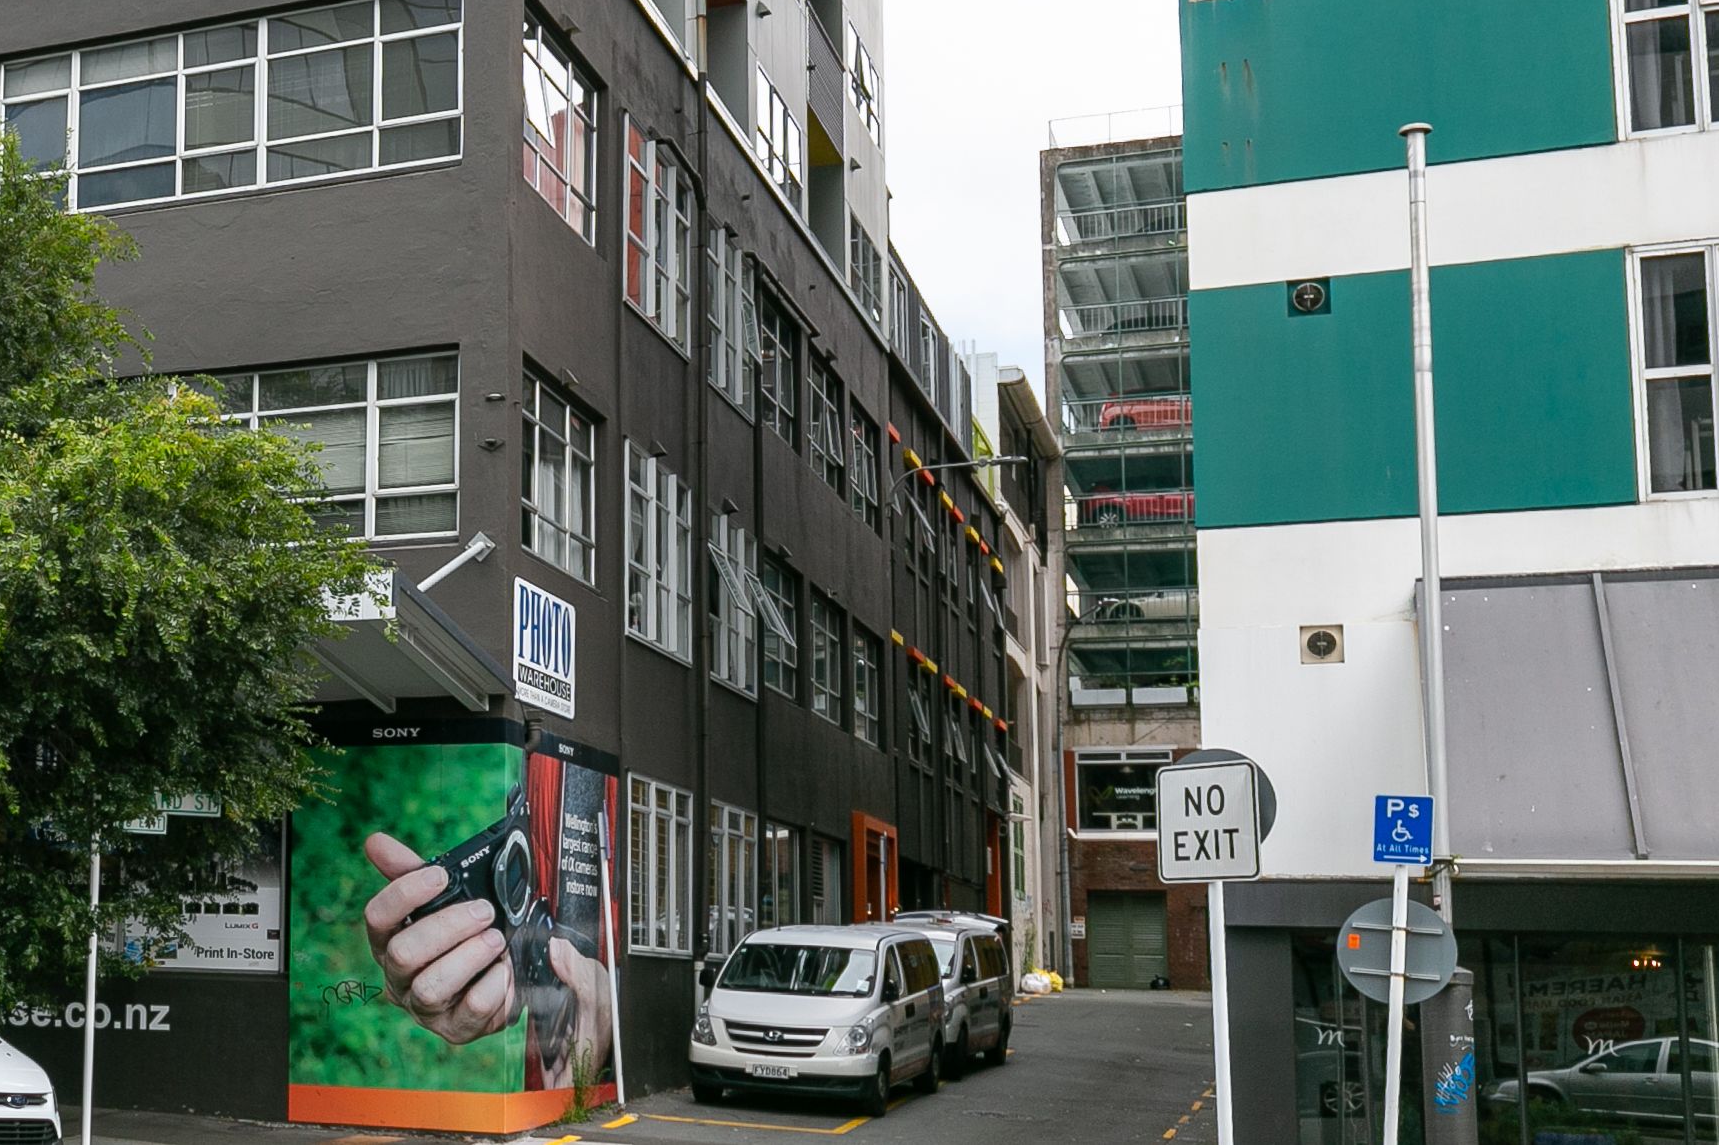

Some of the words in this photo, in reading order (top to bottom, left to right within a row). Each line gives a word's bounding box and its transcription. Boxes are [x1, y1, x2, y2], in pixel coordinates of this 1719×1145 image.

[518, 583, 572, 679] PHOTO
[518, 666, 571, 701] WAREHOUSE
[372, 727, 421, 739] SONY
[558, 743, 575, 756] SONY
[1114, 786, 1156, 796] Waveleng
[1184, 784, 1225, 817] NO
[1387, 798, 1404, 818] P
[564, 812, 598, 835] Wellington's
[562, 833, 581, 854] largest
[582, 841, 598, 858] range
[1173, 828, 1240, 862] EXIT
[1376, 843, 1386, 853] At
[1389, 843, 1401, 853] All
[1404, 844, 1429, 854] Times
[460, 845, 492, 869] SONY
[561, 855, 568, 871] of
[575, 861, 598, 876] cameras
[565, 877, 585, 896] instore
[585, 884, 598, 897] now
[196, 947, 225, 958] Print
[226, 947, 275, 960] In-Store
